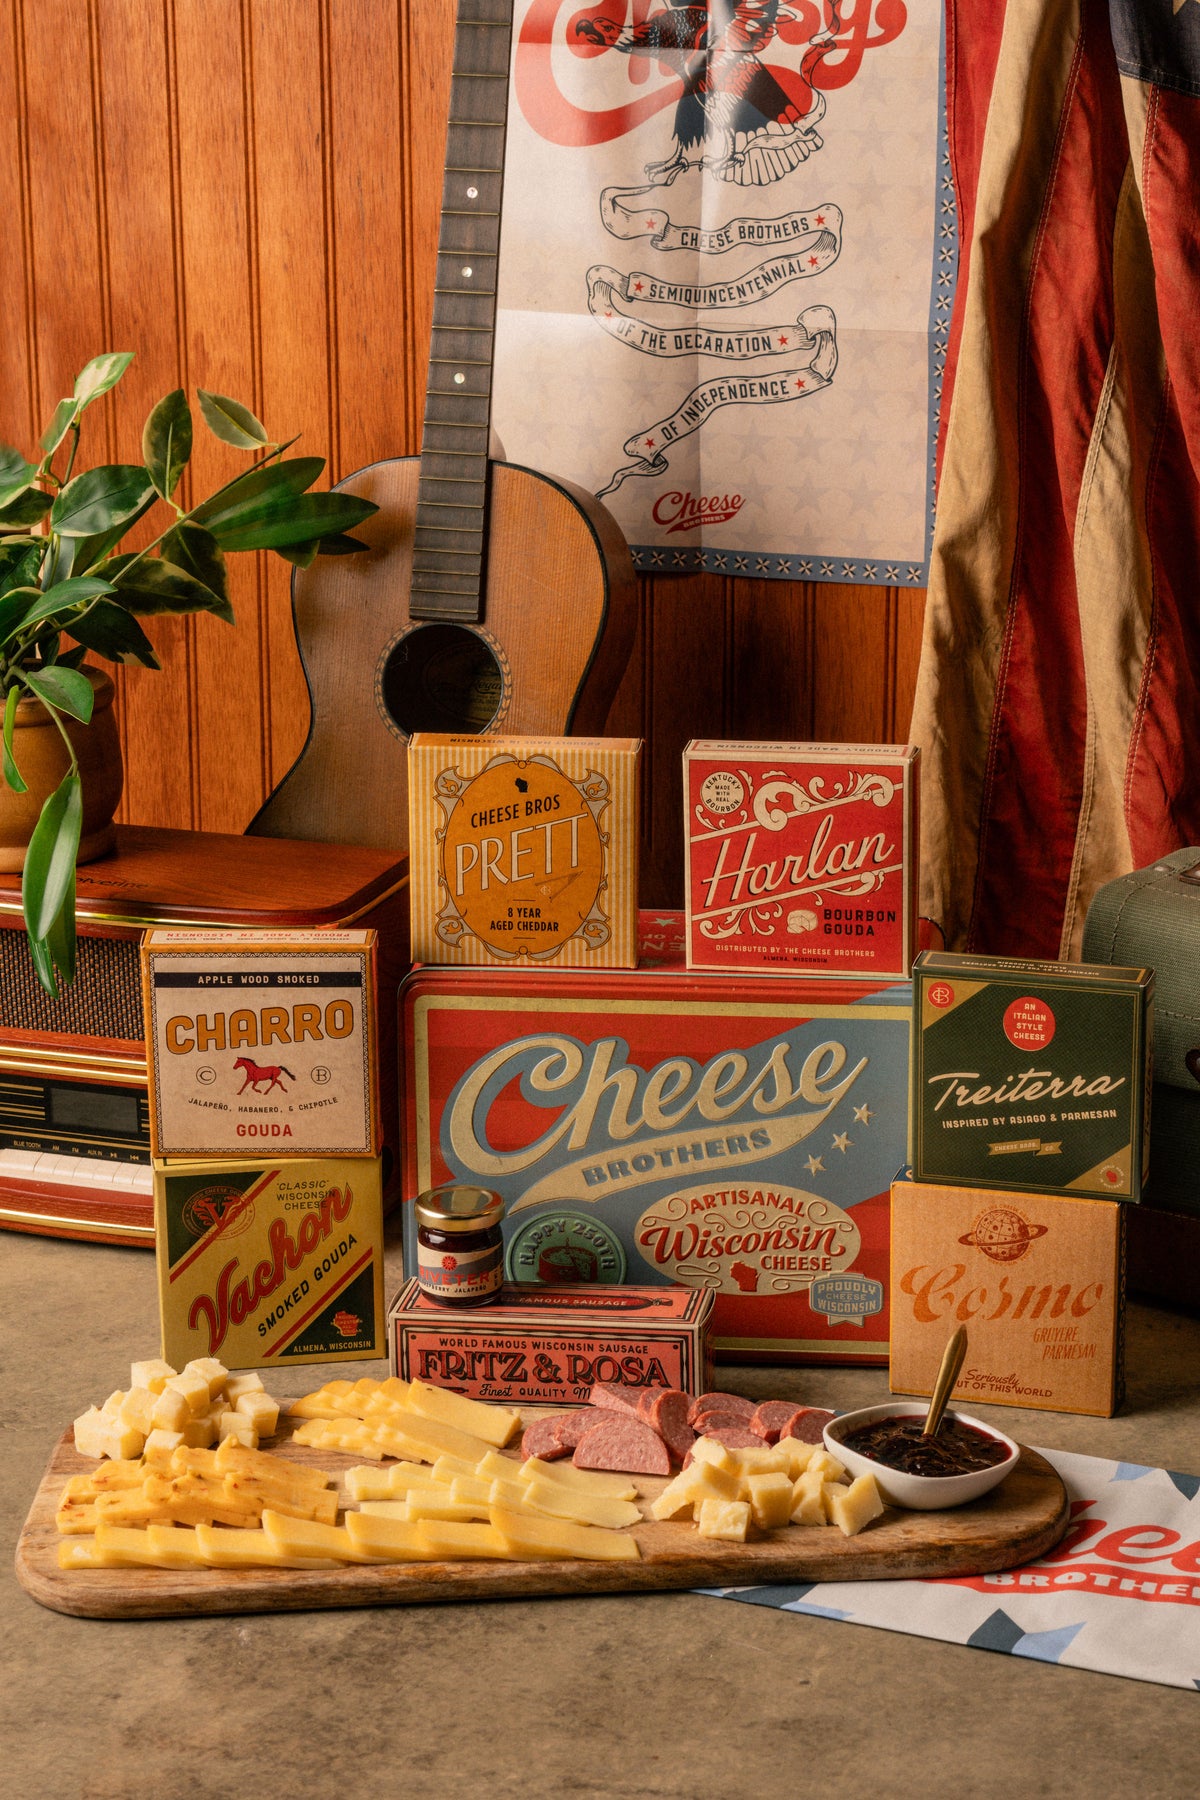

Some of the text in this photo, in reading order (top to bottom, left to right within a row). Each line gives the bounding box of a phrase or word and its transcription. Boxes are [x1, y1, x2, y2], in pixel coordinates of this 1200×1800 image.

[680, 217, 810, 248] CHEESE BROTHERS
[649, 258, 806, 305] SEMIQUINCENTENNIAL
[617, 319, 772, 353] OF THE DECARATION
[660, 380, 790, 441] OF INDEPENDENCE
[652, 491, 747, 525] Cheese
[705, 774, 741, 790] KENTUCKY
[471, 794, 561, 829] CHEESE BROS
[705, 798, 740, 812] BOURBON
[455, 812, 589, 897] PRETT
[701, 813, 895, 908] Harlan
[507, 907, 541, 918] 8 YEAR
[823, 908, 896, 922] BOURBON
[490, 920, 559, 932] AGED CHEDDAR
[823, 923, 874, 936] GOUDA
[715, 944, 767, 953] DISTRIBUTED
[834, 949, 875, 957] BROTHERS
[198, 975, 320, 984] APPLE WOOD SMOKED
[1024, 1003, 1036, 1011] AN
[1013, 1012, 1047, 1022] ITALIAN
[165, 999, 354, 1055] CHARRO
[1016, 1022, 1043, 1031] STYLE
[1013, 1032, 1045, 1041] CHEESE
[928, 1067, 1126, 1112] Treiterra
[298, 1097, 339, 1111] CHIPOTLE
[450, 1036, 868, 1176] Cheese
[942, 1109, 1117, 1129] INSPIRED BY ASIAGO & PARMESAN
[236, 1124, 293, 1137] GOUDA
[581, 1128, 772, 1187] BROTHERS
[276, 1190, 336, 1201] WISCONSIN
[690, 1189, 805, 1218] ARTISANAL
[284, 1200, 327, 1211] CHEESE
[519, 1219, 616, 1269] HAPPY 250TH
[639, 1223, 846, 1264] Wisconsin
[188, 1182, 353, 1358] Vachon
[760, 1255, 832, 1271] CHEESE
[418, 1264, 490, 1286] RIVETER
[257, 1278, 310, 1338] SMOKED
[313, 1233, 358, 1282] GOUDA
[817, 1281, 877, 1295] PROUDLY
[899, 1263, 1104, 1323] Cosmo
[817, 1298, 877, 1313] WISCONSIN
[825, 1293, 867, 1301] CHEESE
[1033, 1327, 1080, 1343] GRUYERE
[293, 1340, 372, 1353] ALMENA, WISCONSIN
[439, 1337, 649, 1354] WORLD FAMOUS WISCONSIN SAUSAGE
[1042, 1343, 1097, 1360] PARMESAN
[418, 1349, 672, 1389] FRITZ & ROSA
[479, 1383, 513, 1397] Finest
[519, 1387, 567, 1397] QUALITY
[956, 1380, 1053, 1397] UT OF THIS WORLD
[983, 1571, 1200, 1599] BROTHE
